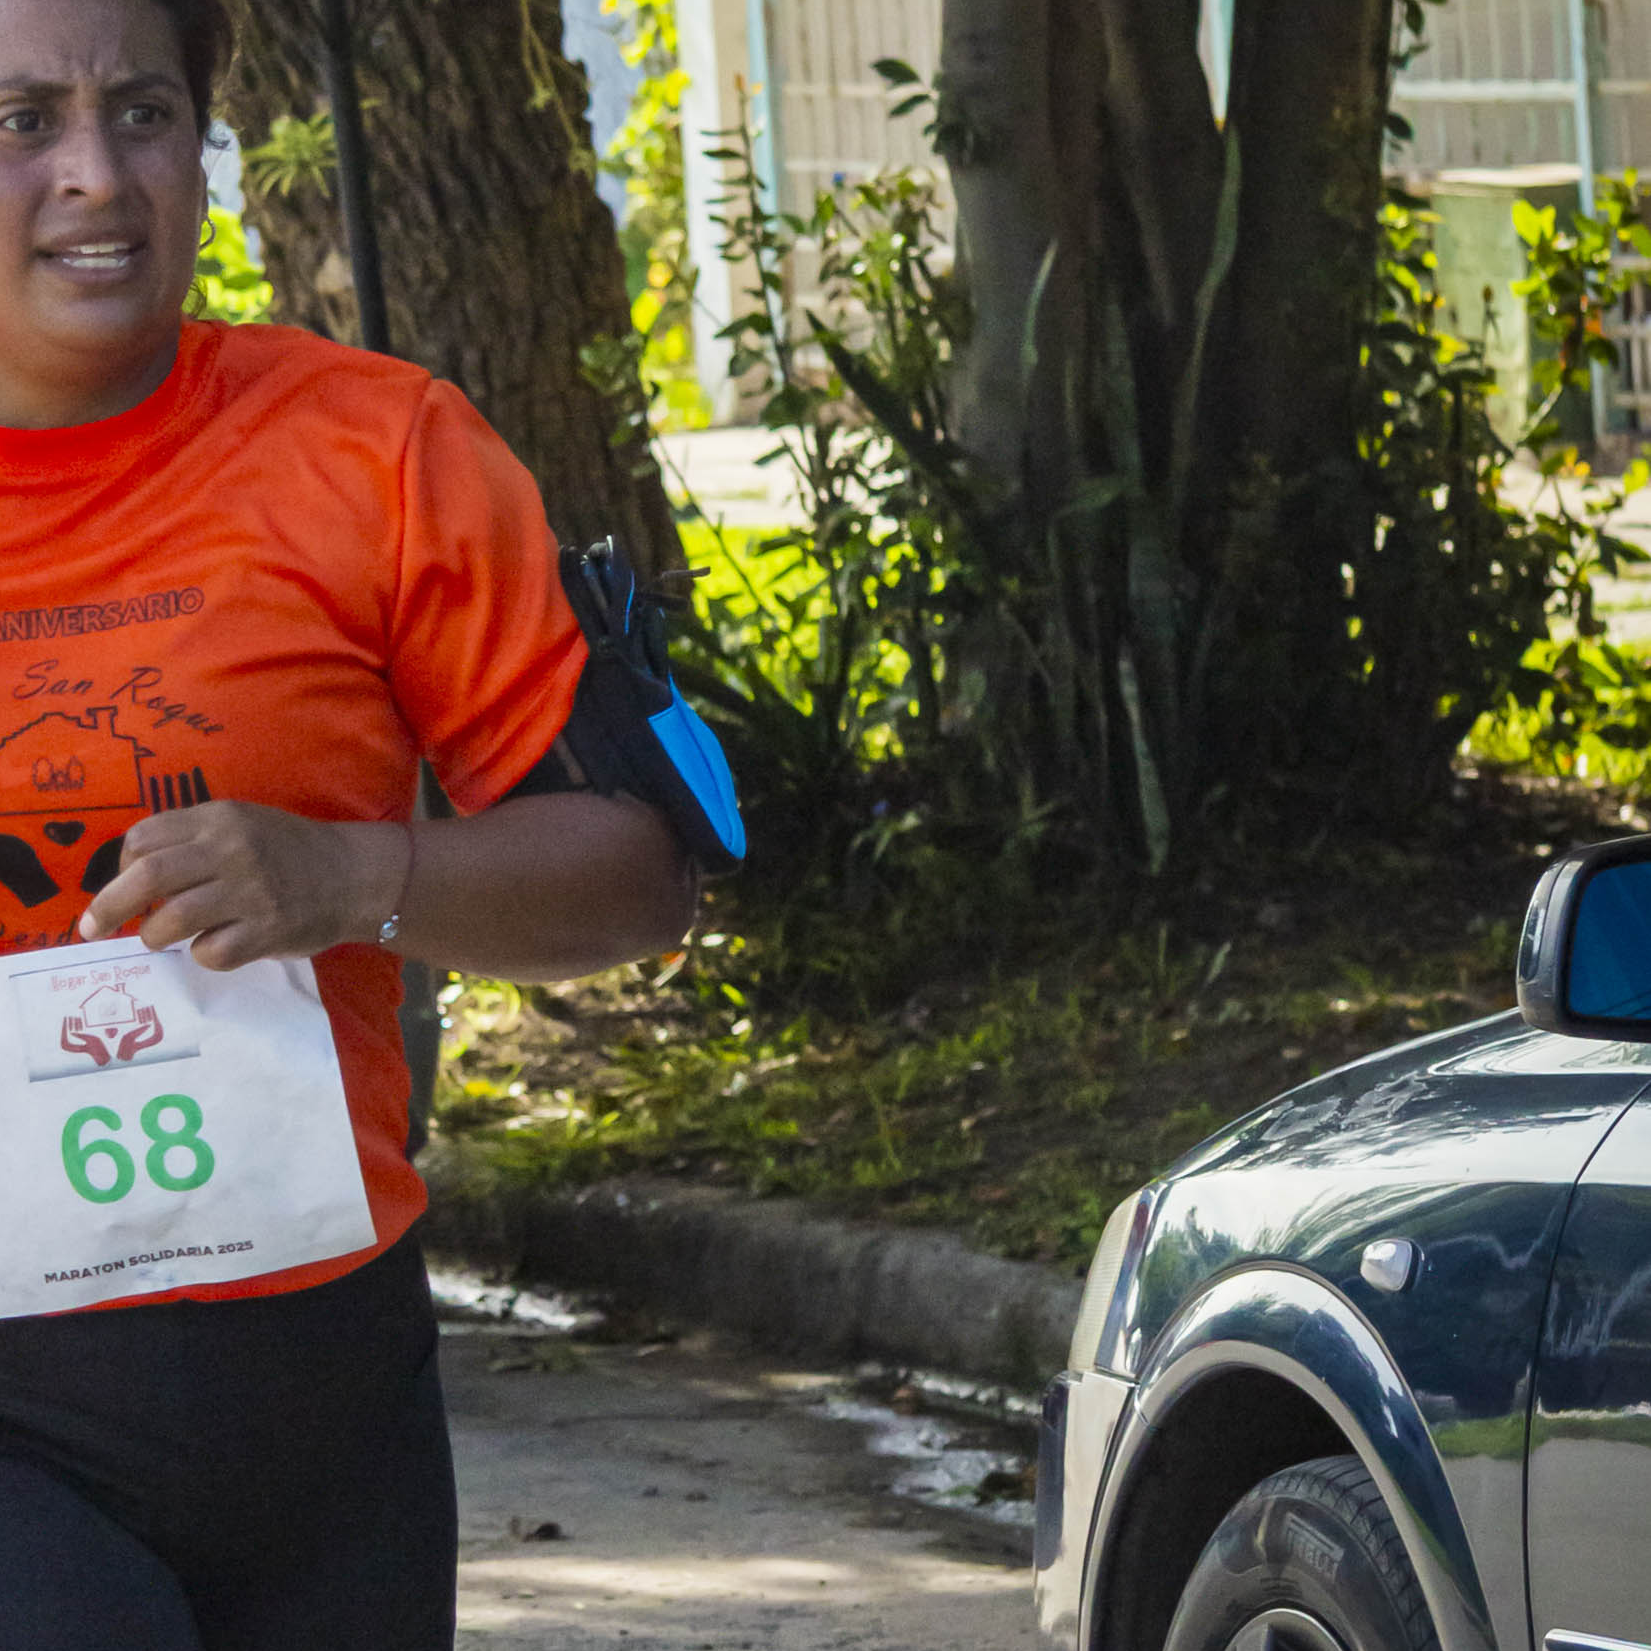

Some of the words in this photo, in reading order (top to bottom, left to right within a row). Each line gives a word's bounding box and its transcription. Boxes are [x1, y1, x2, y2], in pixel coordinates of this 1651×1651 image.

[12, 659, 94, 700] San
[110, 666, 224, 736] Roque
[61, 1093, 216, 1205] 68
[44, 1260, 126, 1284] MARATON
[128, 1245, 214, 1267] SOLIDARIA
[217, 1240, 255, 1255] 2025
